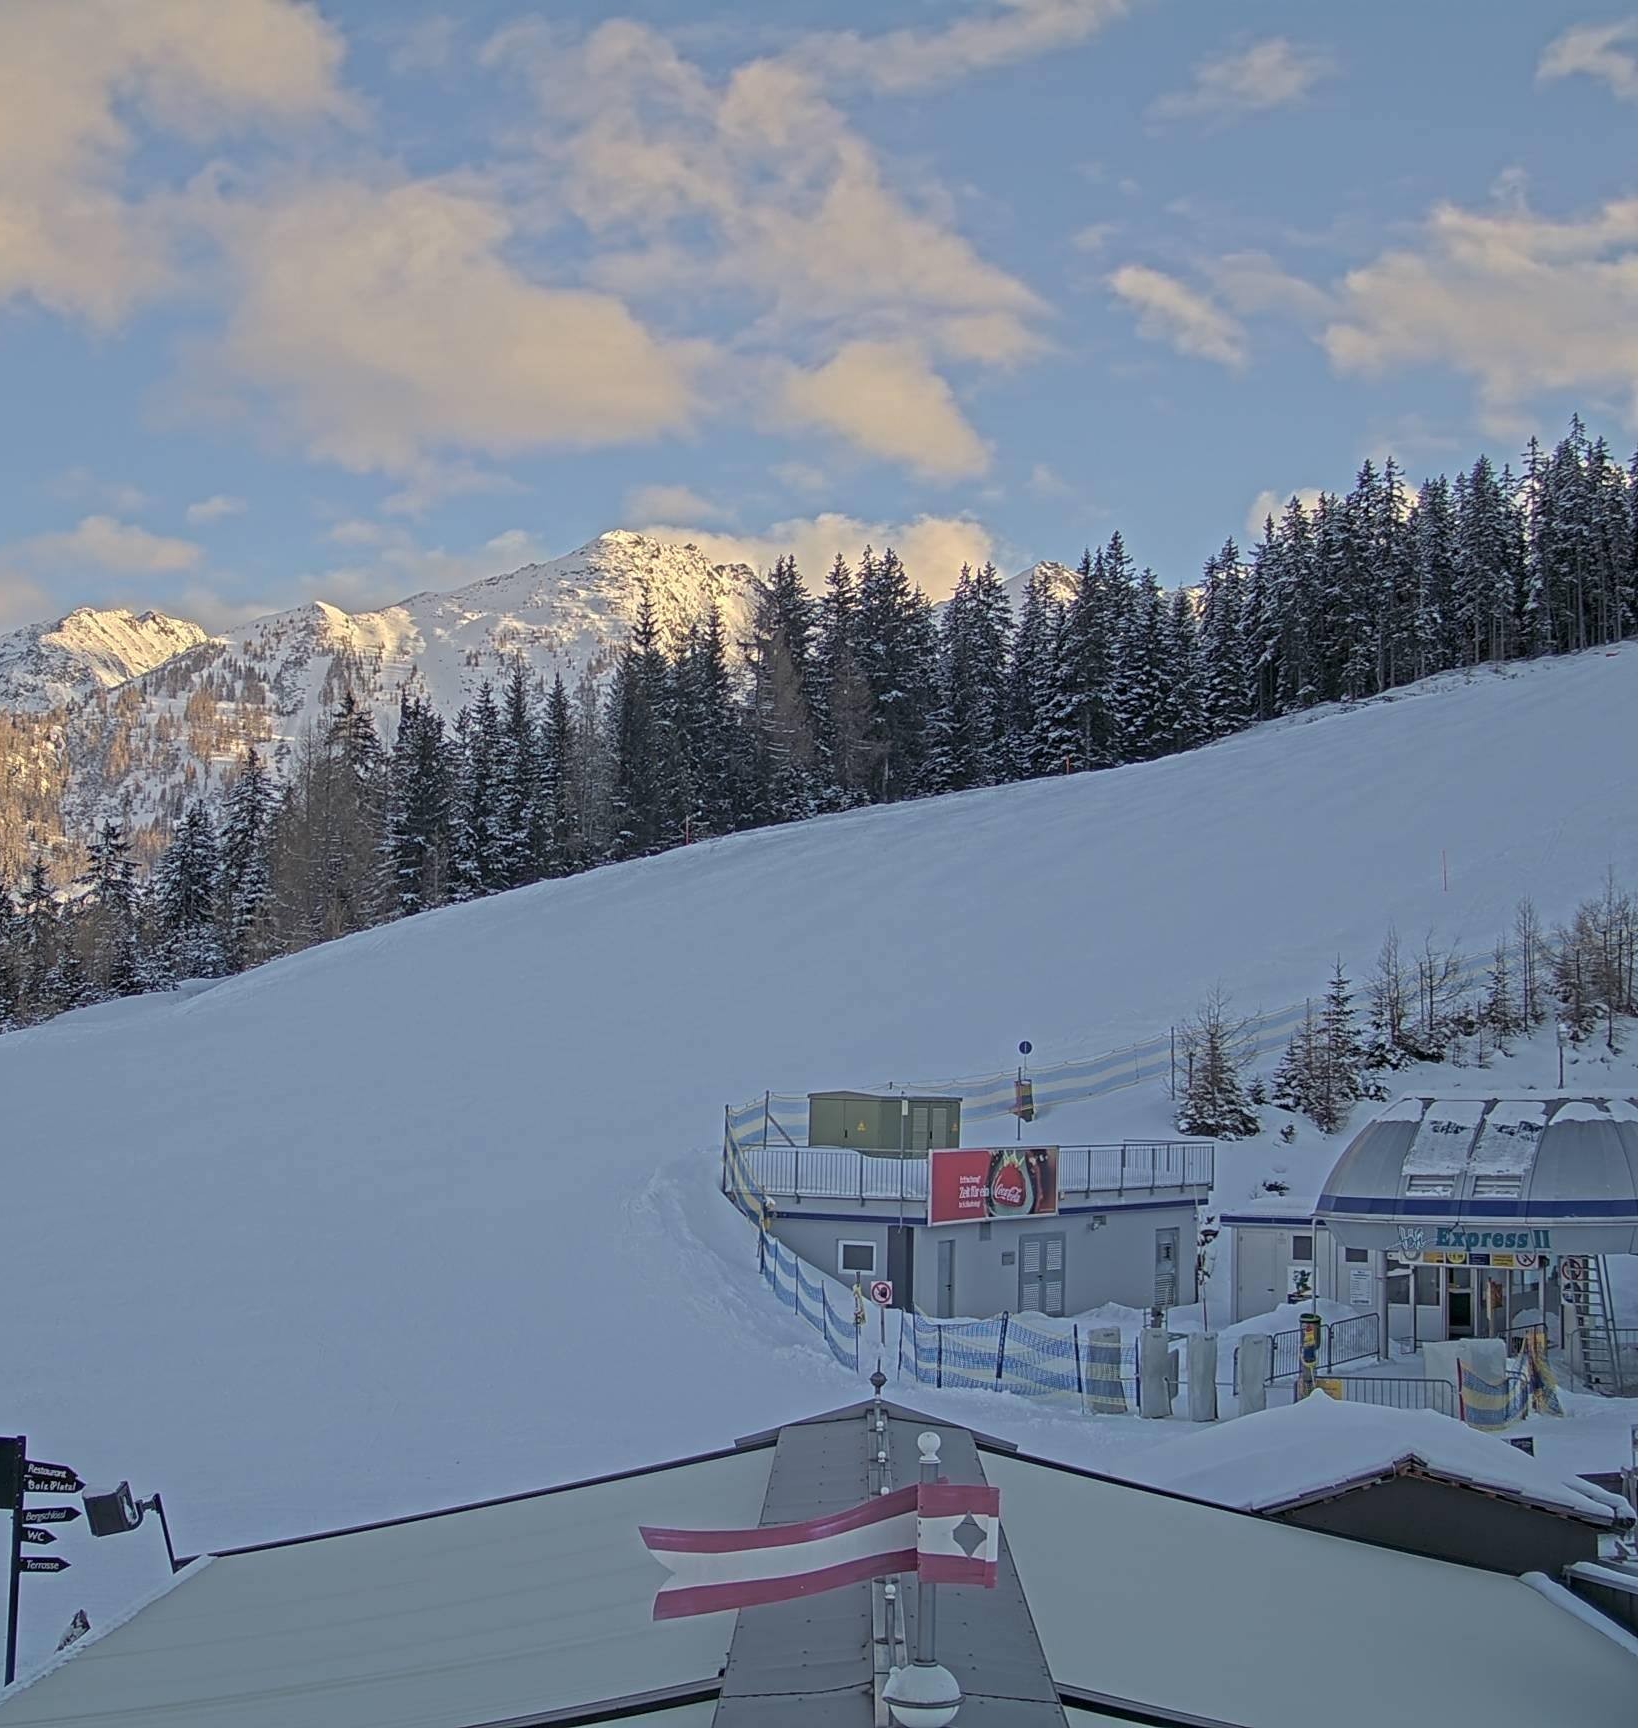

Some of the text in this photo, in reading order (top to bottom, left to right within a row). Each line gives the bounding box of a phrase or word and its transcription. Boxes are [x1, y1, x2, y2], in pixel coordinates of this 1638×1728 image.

[1436, 1227, 1528, 1252] Express
[1533, 1229, 1551, 1249] II
[27, 1463, 67, 1478] Restaurant
[27, 1530, 46, 1541] WC
[26, 1559, 60, 1570] Terrasse
